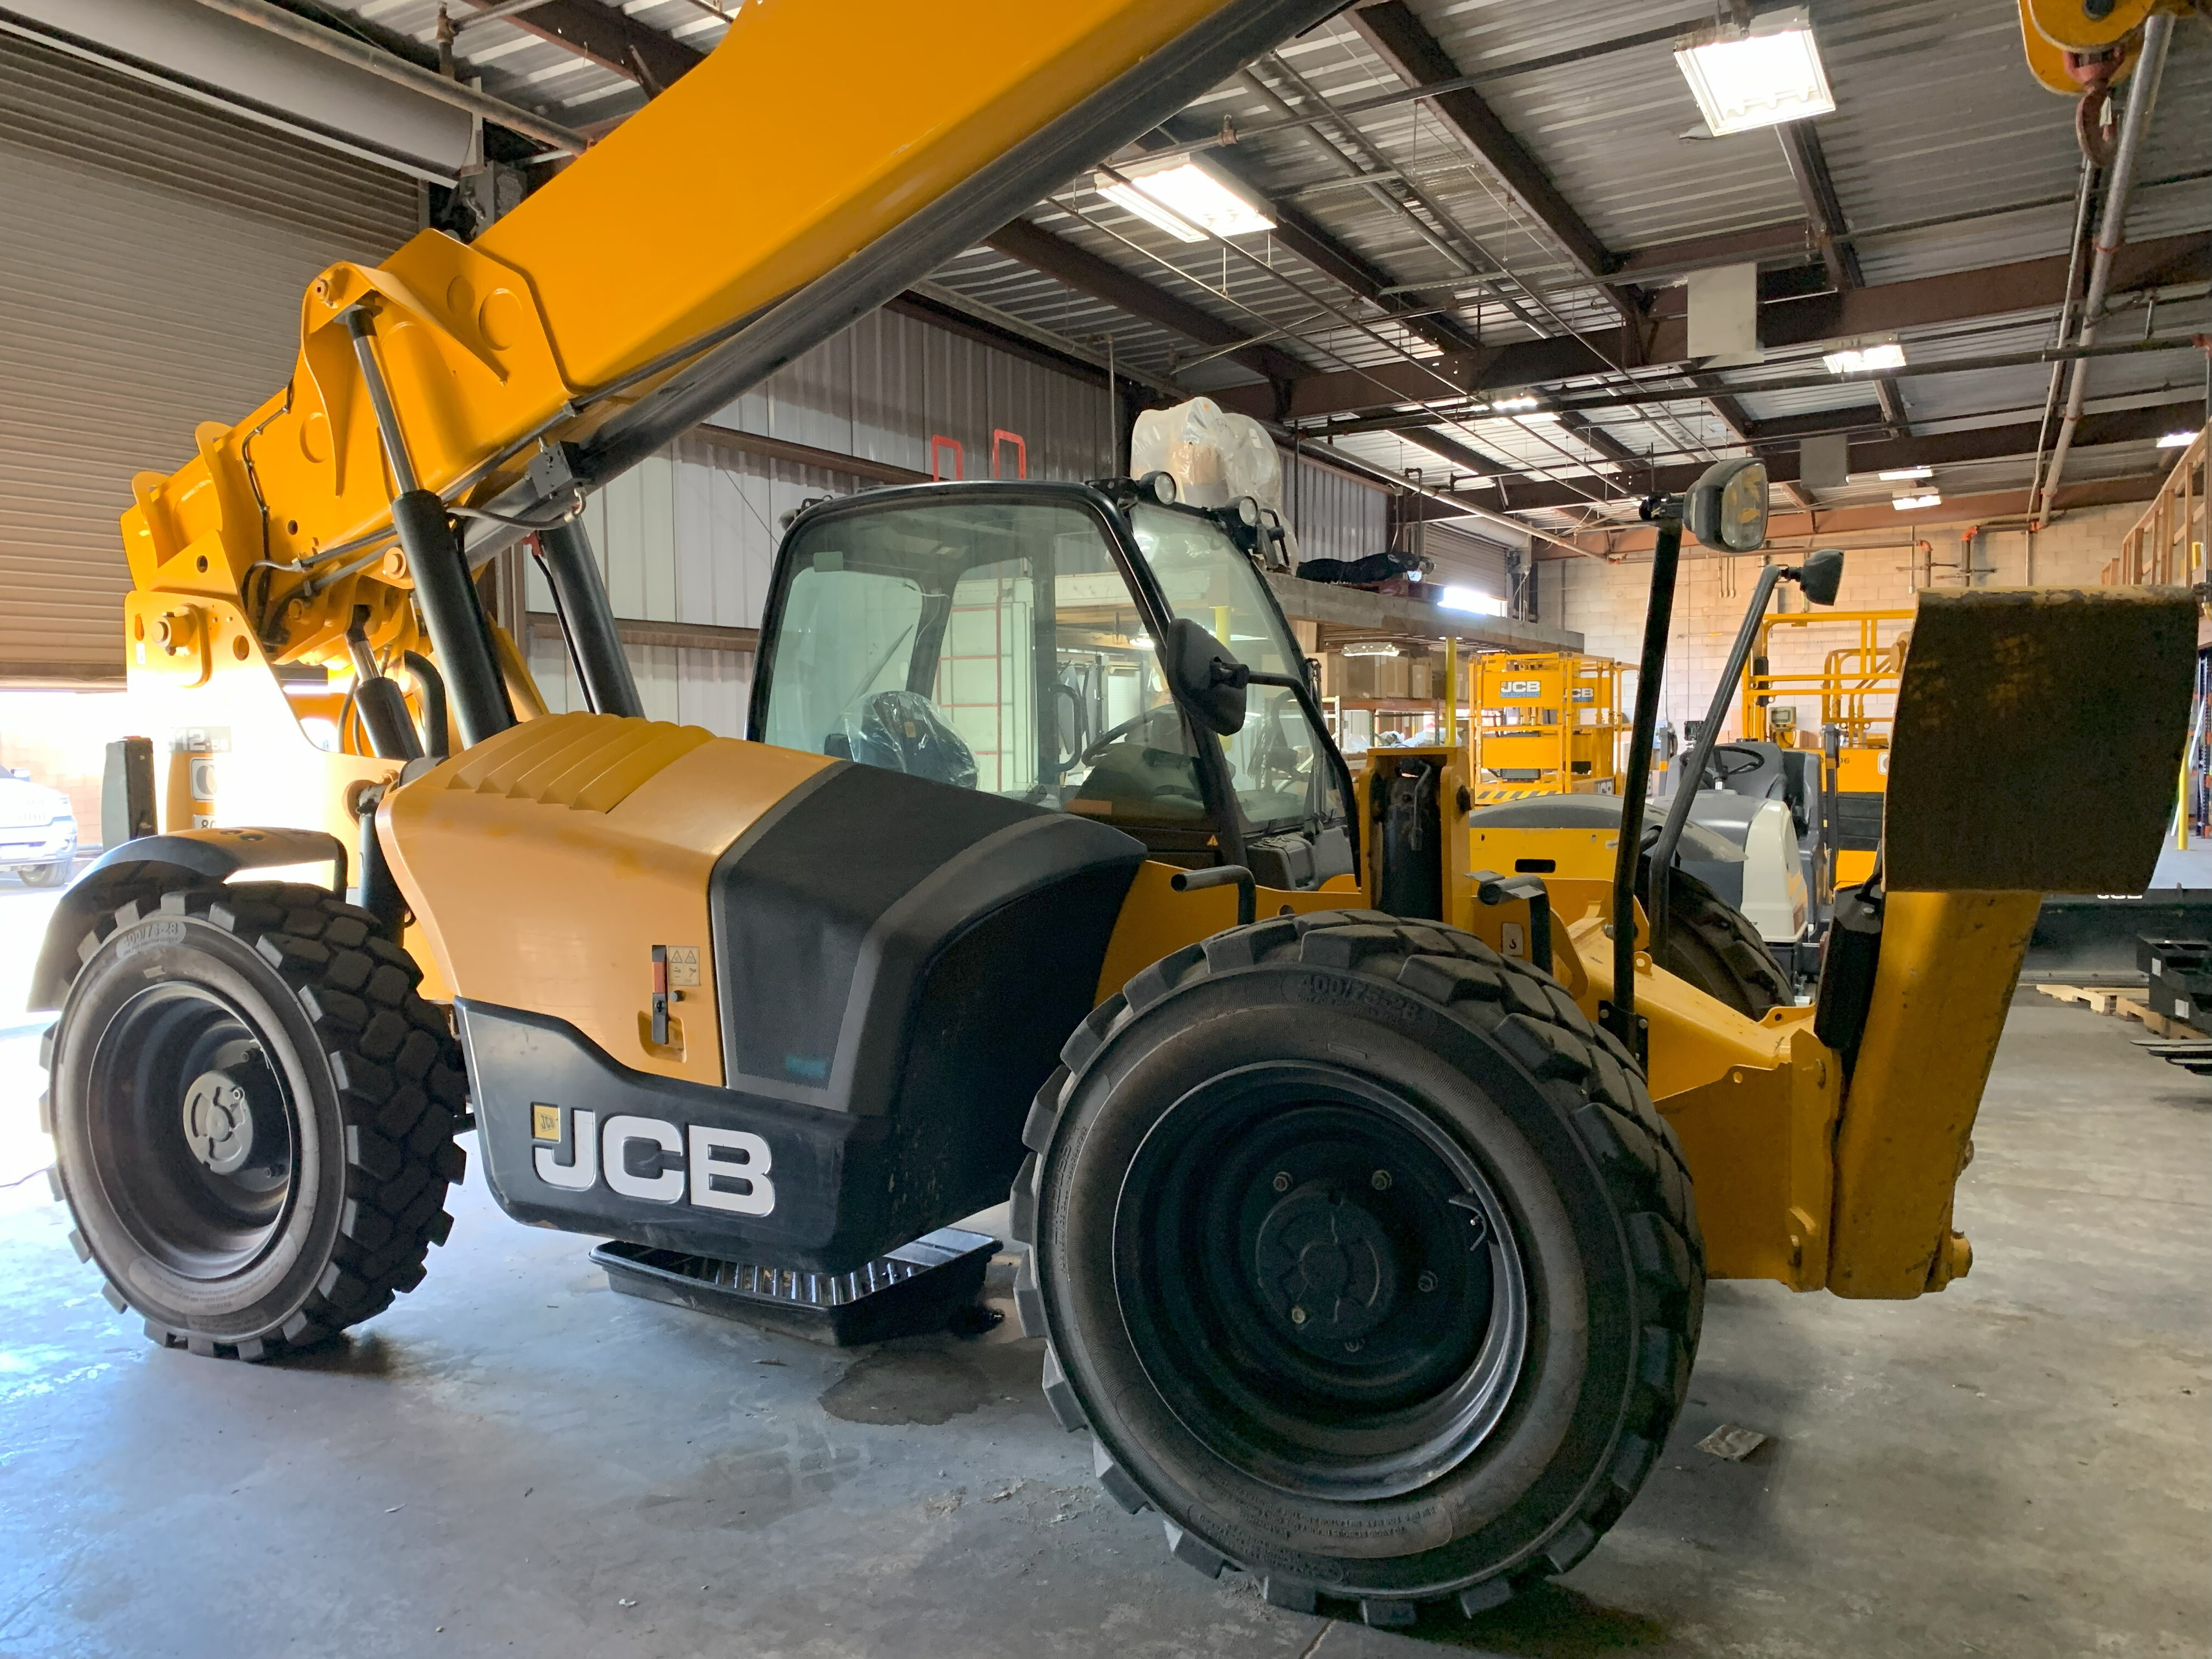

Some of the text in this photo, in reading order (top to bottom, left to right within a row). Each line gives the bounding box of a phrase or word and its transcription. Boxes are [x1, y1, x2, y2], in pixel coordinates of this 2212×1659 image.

[1500, 681, 1541, 692] JCB
[540, 1114, 554, 1129] JCB
[533, 1109, 775, 1217] JCB
